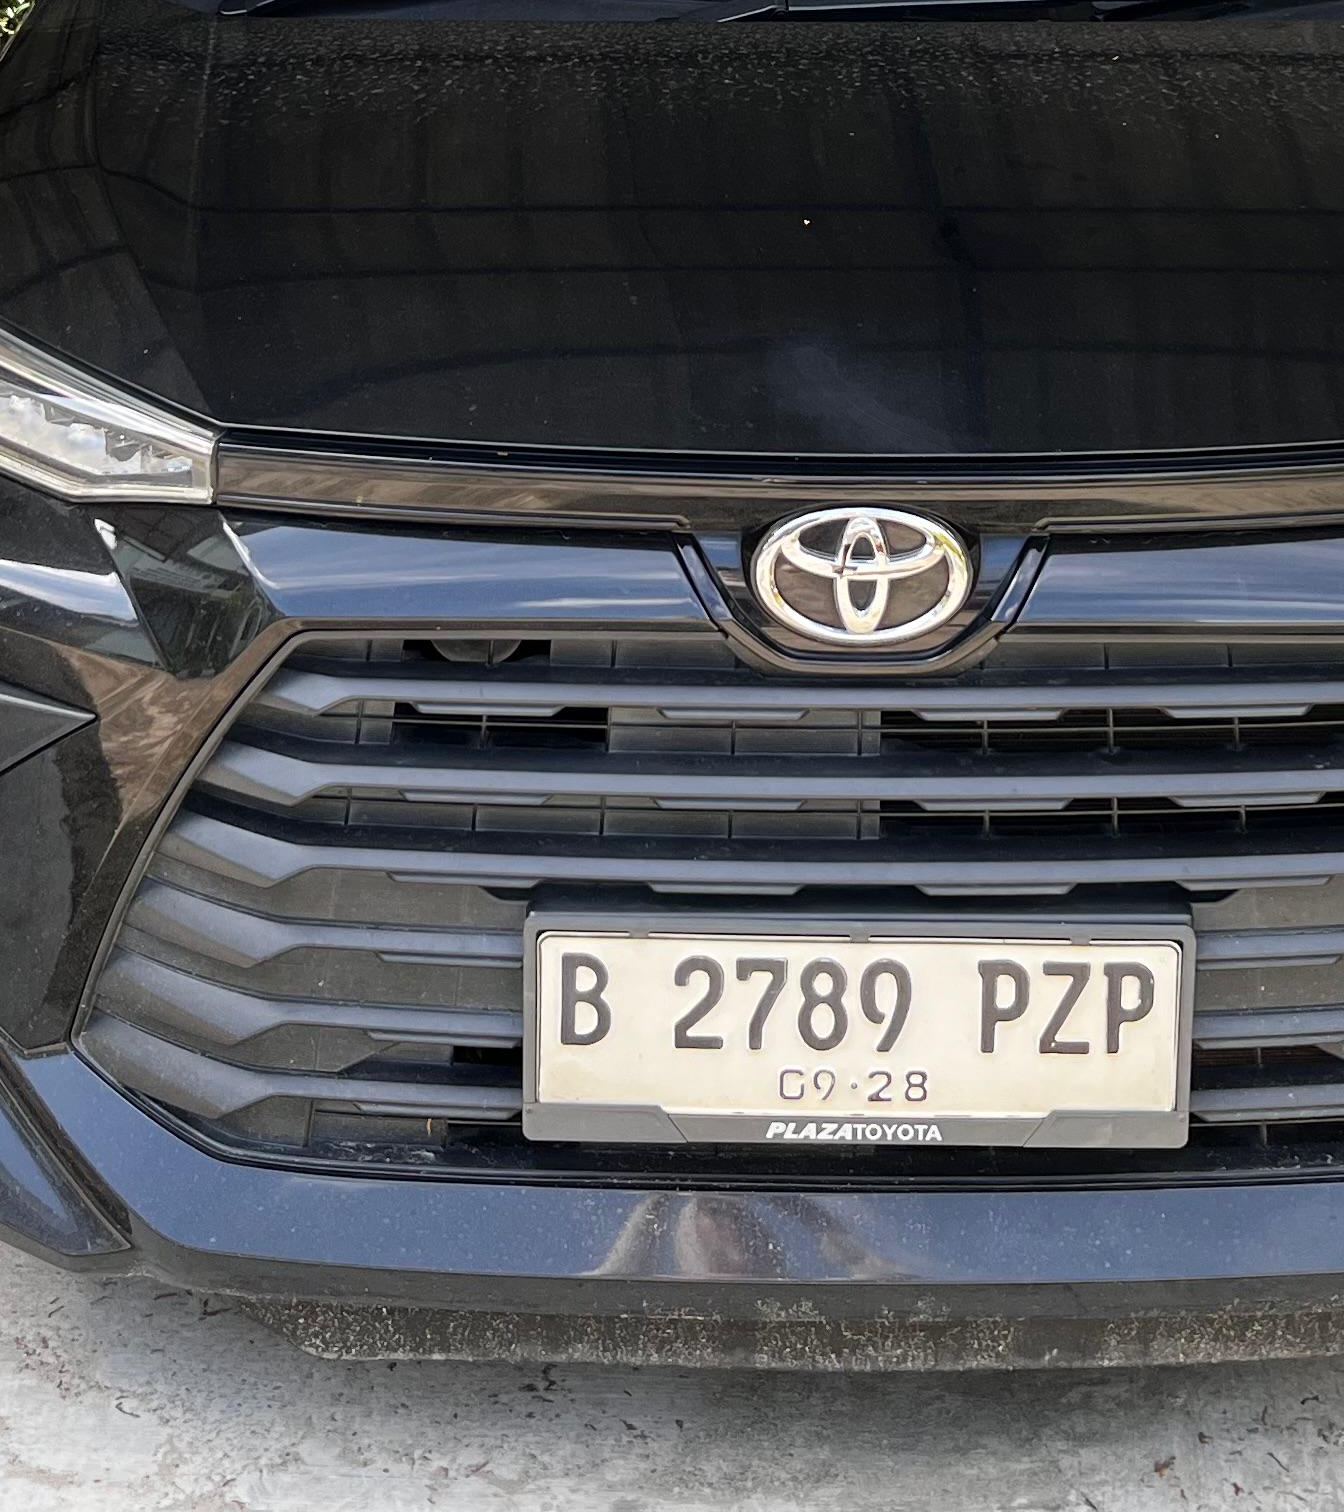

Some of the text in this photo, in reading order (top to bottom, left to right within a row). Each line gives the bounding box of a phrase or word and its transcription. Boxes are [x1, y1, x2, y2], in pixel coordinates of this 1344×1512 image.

[560, 951, 1155, 1054] B 2789 PZP
